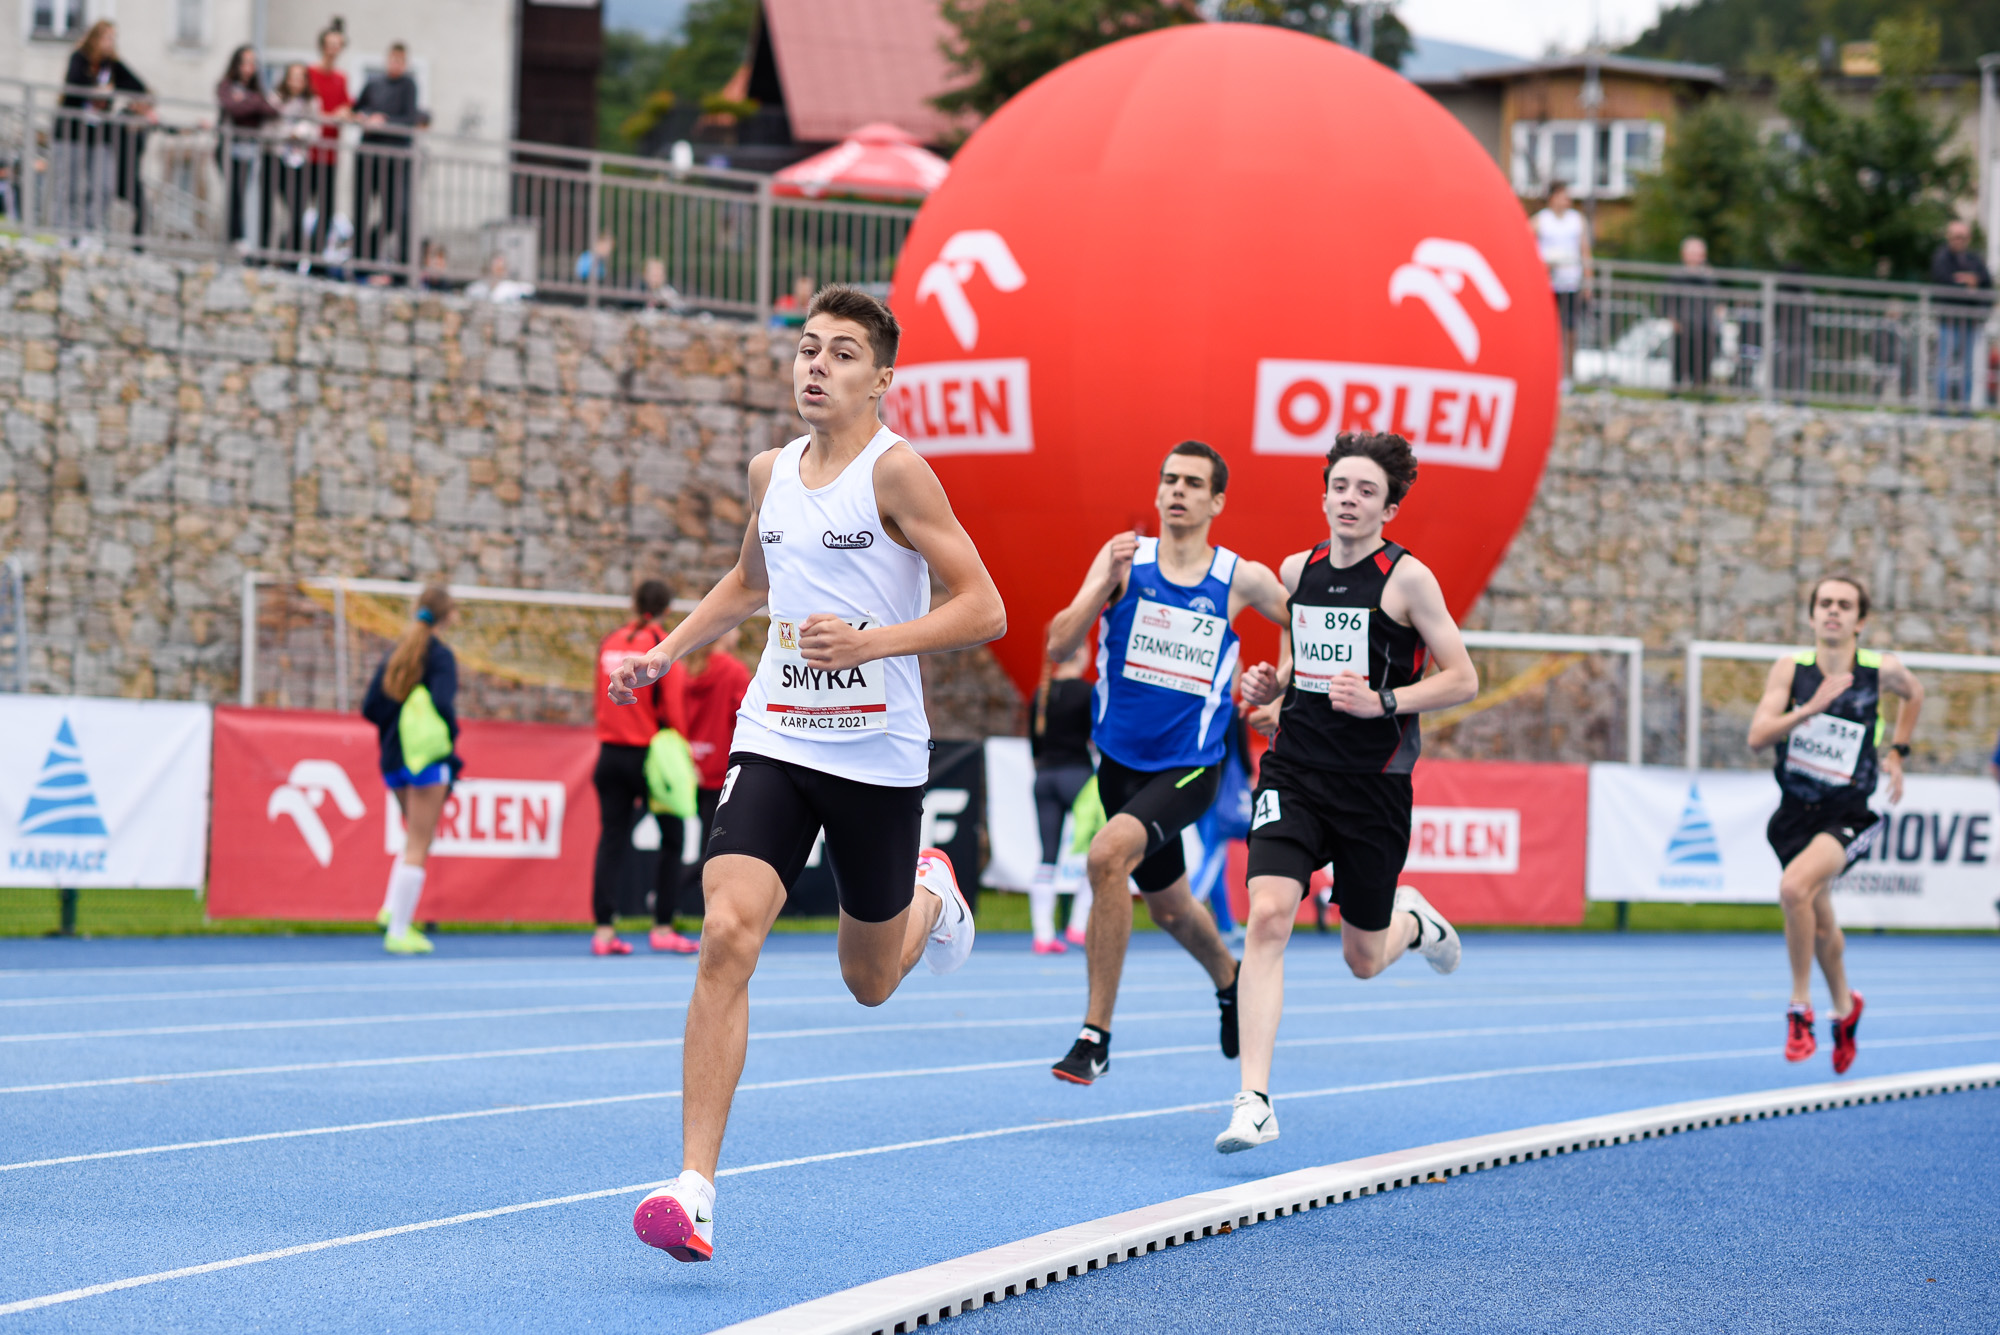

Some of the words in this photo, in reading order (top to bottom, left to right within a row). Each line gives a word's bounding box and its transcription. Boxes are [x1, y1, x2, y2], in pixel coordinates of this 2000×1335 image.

[885, 376, 1011, 438] RLEN
[1278, 379, 1497, 449] ORLEN
[1192, 617, 1214, 636] 75
[1325, 612, 1362, 630] 896
[1133, 634, 1214, 667] STANKIEWICZ
[1300, 642, 1352, 662] MADEJ
[782, 664, 867, 690] SMYKA
[780, 716, 834, 729] KARPACZ
[838, 716, 867, 728] 2021
[434, 795, 549, 842] RLEN
[1420, 822, 1506, 859] RLEN
